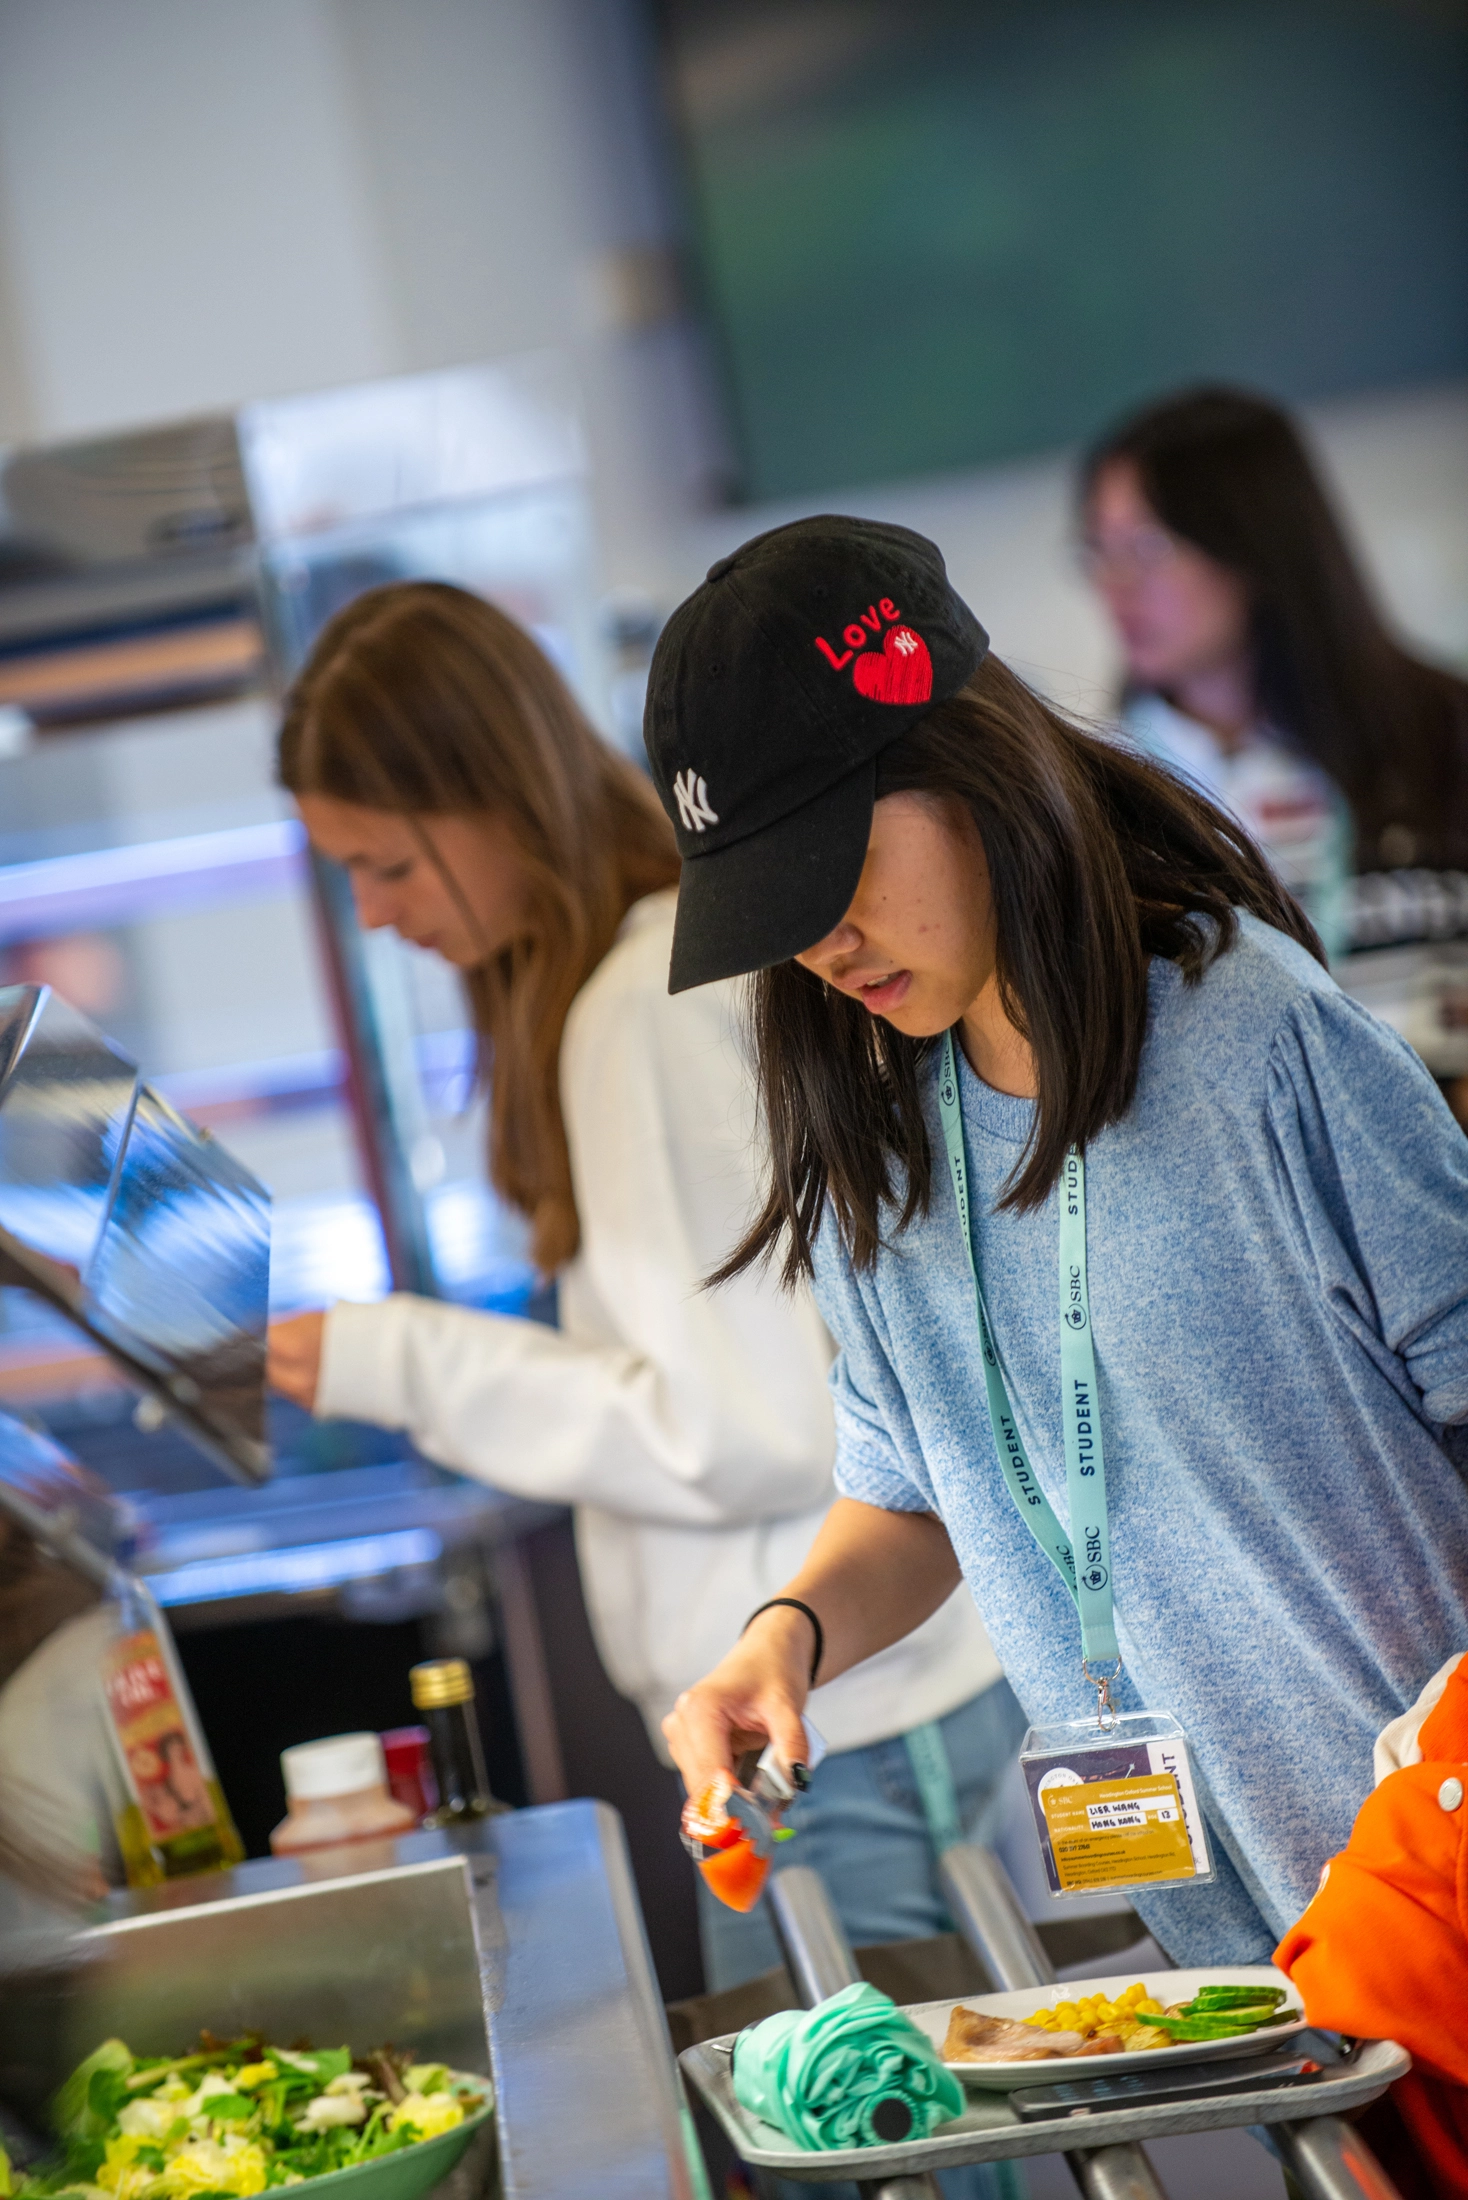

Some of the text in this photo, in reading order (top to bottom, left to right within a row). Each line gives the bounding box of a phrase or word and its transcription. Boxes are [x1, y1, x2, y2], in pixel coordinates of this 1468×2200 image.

[815, 597, 901, 672] Love
[894, 631, 918, 656] NY
[673, 768, 719, 832] NY
[1068, 1144, 1078, 1216] STUDE
[1069, 1265, 1082, 1302] SBC
[1074, 1379, 1095, 1477] STUDENT
[1000, 1415, 1041, 1506] STUDENT
[1084, 1526, 1102, 1563] SBC
[1058, 1797, 1073, 1805] SBC
[1112, 1802, 1140, 1812] WANG
[1161, 1810, 1171, 1819] 13
[1091, 1815, 1141, 1829] HONG KONG
